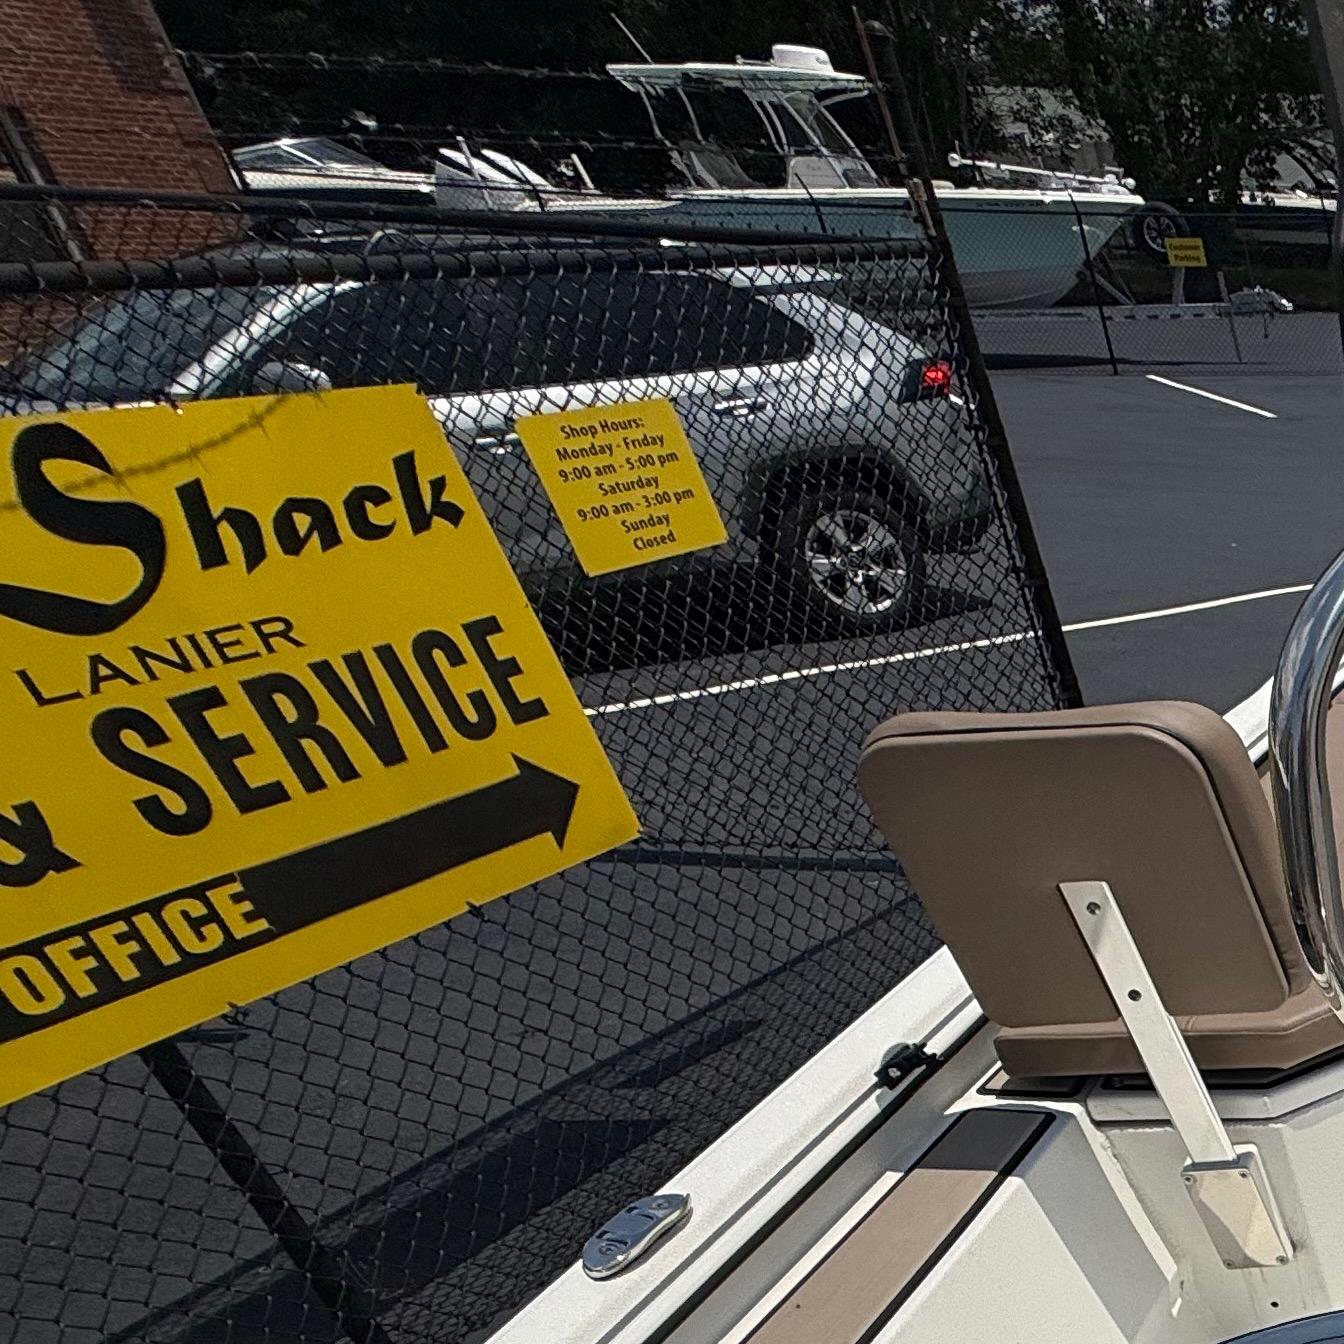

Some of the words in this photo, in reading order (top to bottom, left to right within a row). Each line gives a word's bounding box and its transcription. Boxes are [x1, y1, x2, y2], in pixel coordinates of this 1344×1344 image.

[560, 424, 598, 441] Shop
[600, 417, 645, 434] Hours:
[555, 443, 614, 462] Monday
[623, 432, 665, 451] Friday
[558, 466, 591, 483] 9:00
[594, 464, 617, 477] am
[625, 454, 655, 471] 5:00
[658, 451, 679, 468] pm
[598, 474, 660, 497] Saturday
[577, 503, 609, 523] 9:00
[612, 502, 635, 515] am
[642, 492, 672, 509] 3:00
[674, 487, 695, 504] pm
[0, 422, 465, 636] Shack
[621, 512, 671, 534] Sunday
[633, 529, 677, 551] Closed
[15, 615, 306, 708] LANIER
[90, 615, 551, 837] SERVICE
[3, 873, 275, 1016] OFFICE
